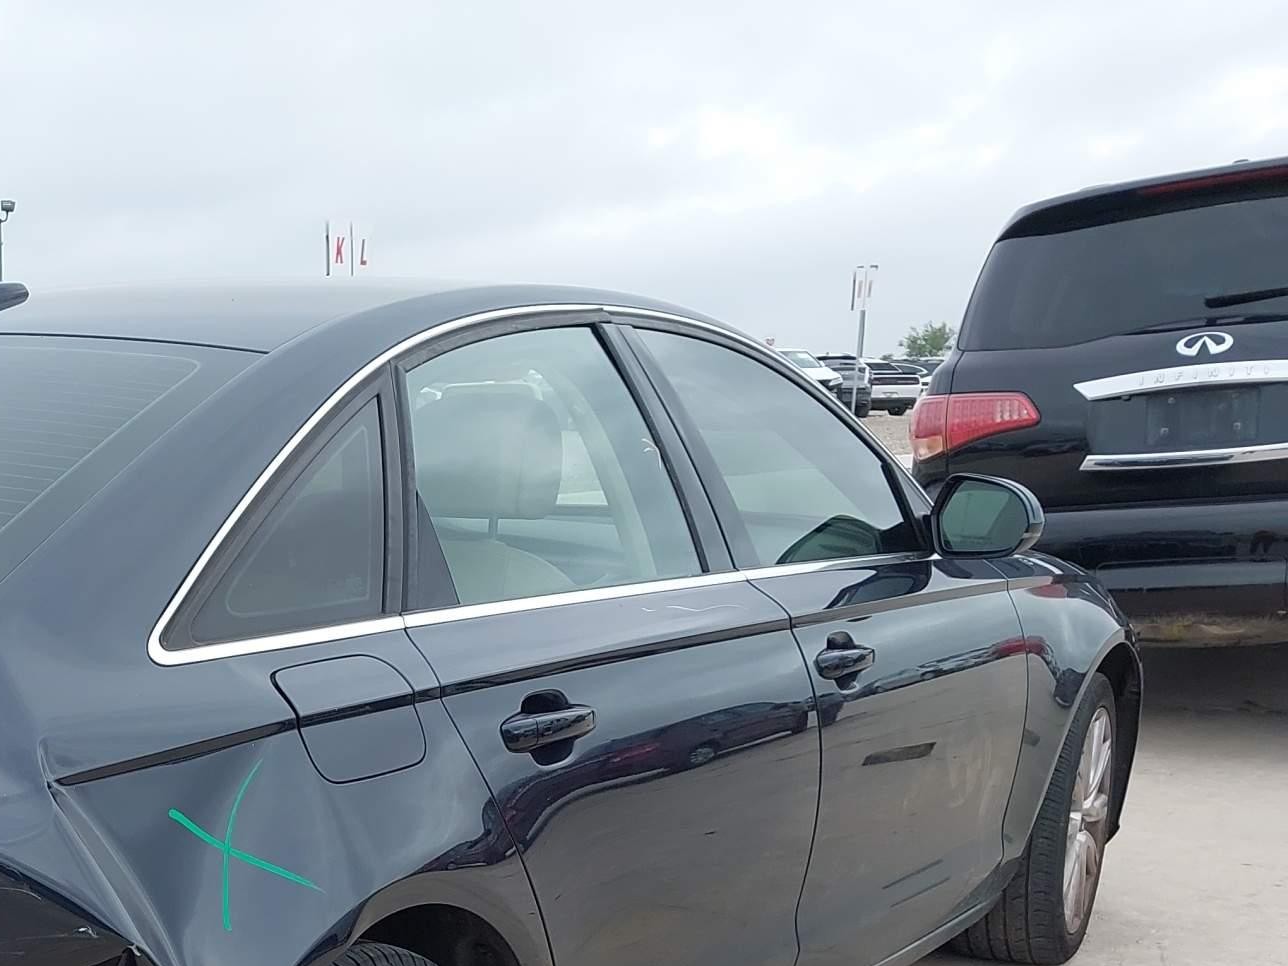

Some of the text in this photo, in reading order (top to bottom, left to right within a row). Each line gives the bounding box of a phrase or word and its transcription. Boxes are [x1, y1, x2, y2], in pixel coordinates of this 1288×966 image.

[335, 236, 345, 264] K
[360, 239, 367, 266] L
[1137, 364, 1271, 387] INFINITI
